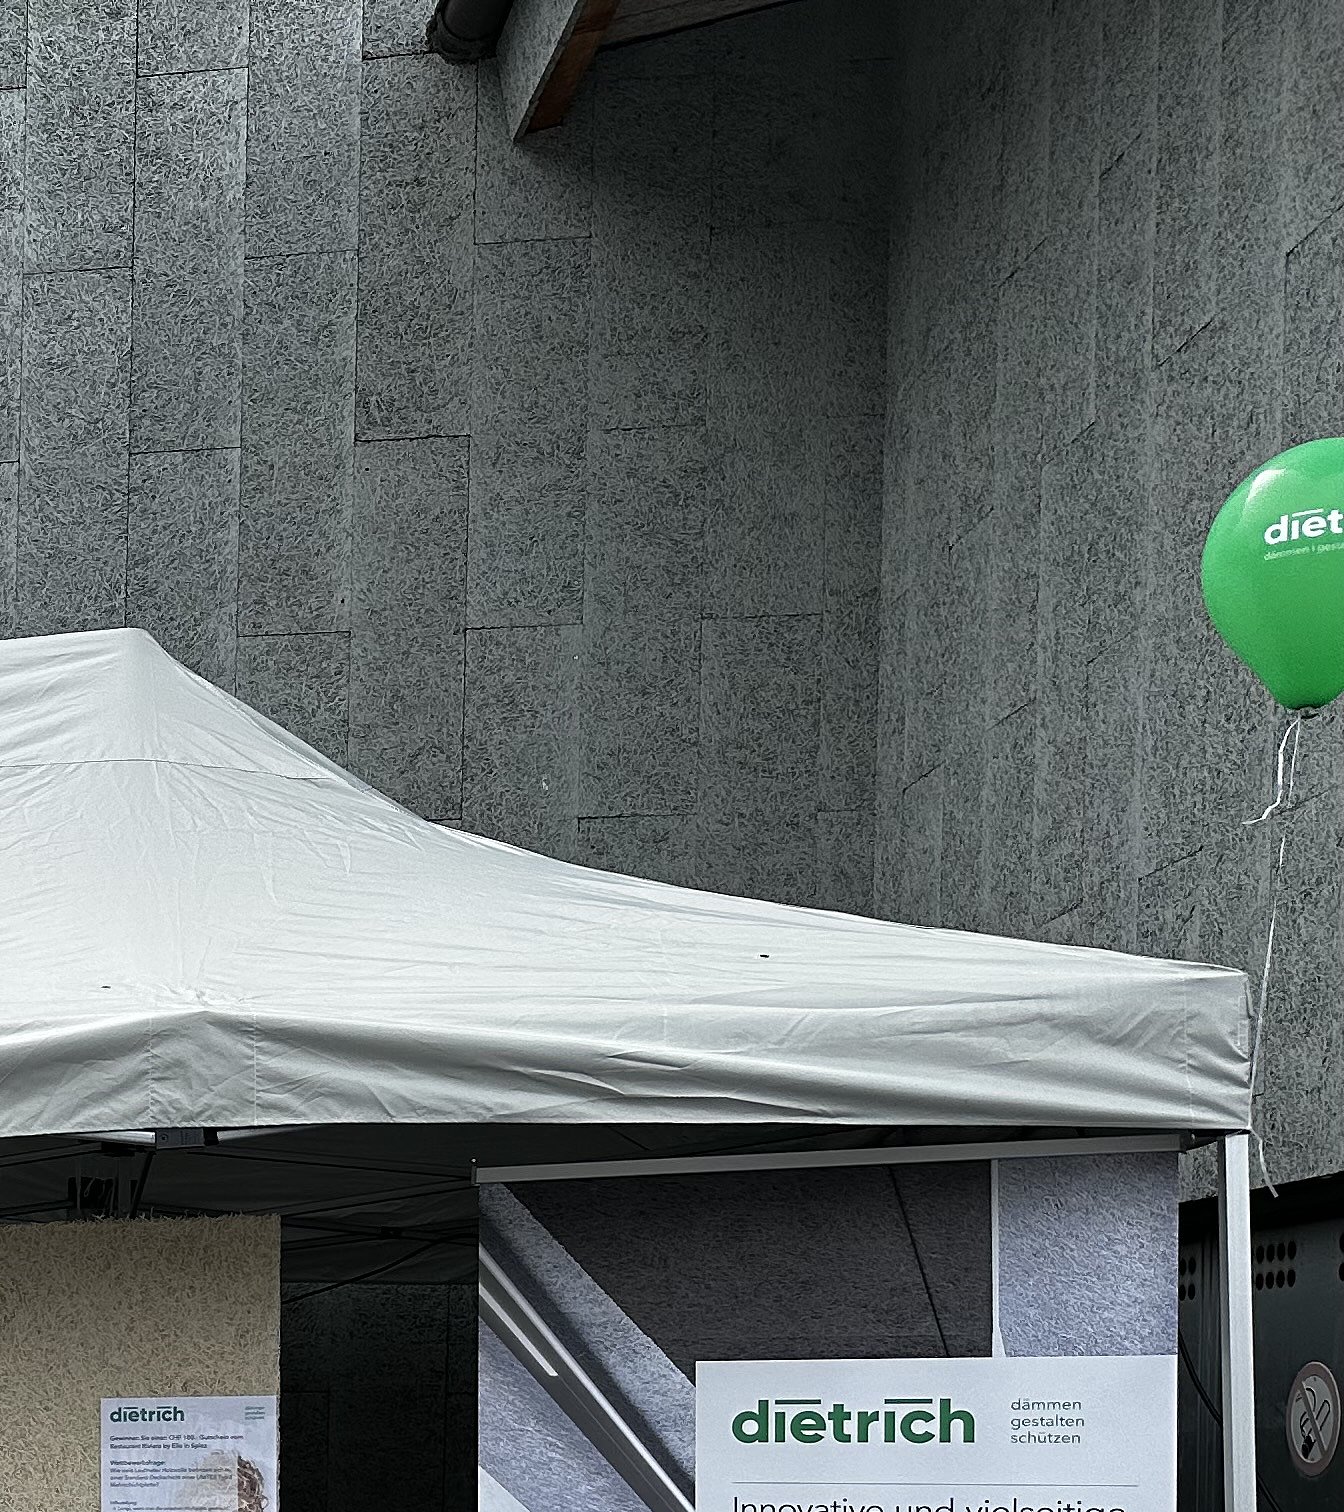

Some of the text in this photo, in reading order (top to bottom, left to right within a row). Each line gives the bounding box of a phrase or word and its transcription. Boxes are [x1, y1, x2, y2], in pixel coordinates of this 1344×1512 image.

[1011, 1399, 1082, 1411] dämmen
[110, 1406, 185, 1422] dietrich
[732, 1398, 976, 1444] dietrich
[1011, 1415, 1085, 1429] gestalten
[1011, 1431, 1082, 1444] schützen
